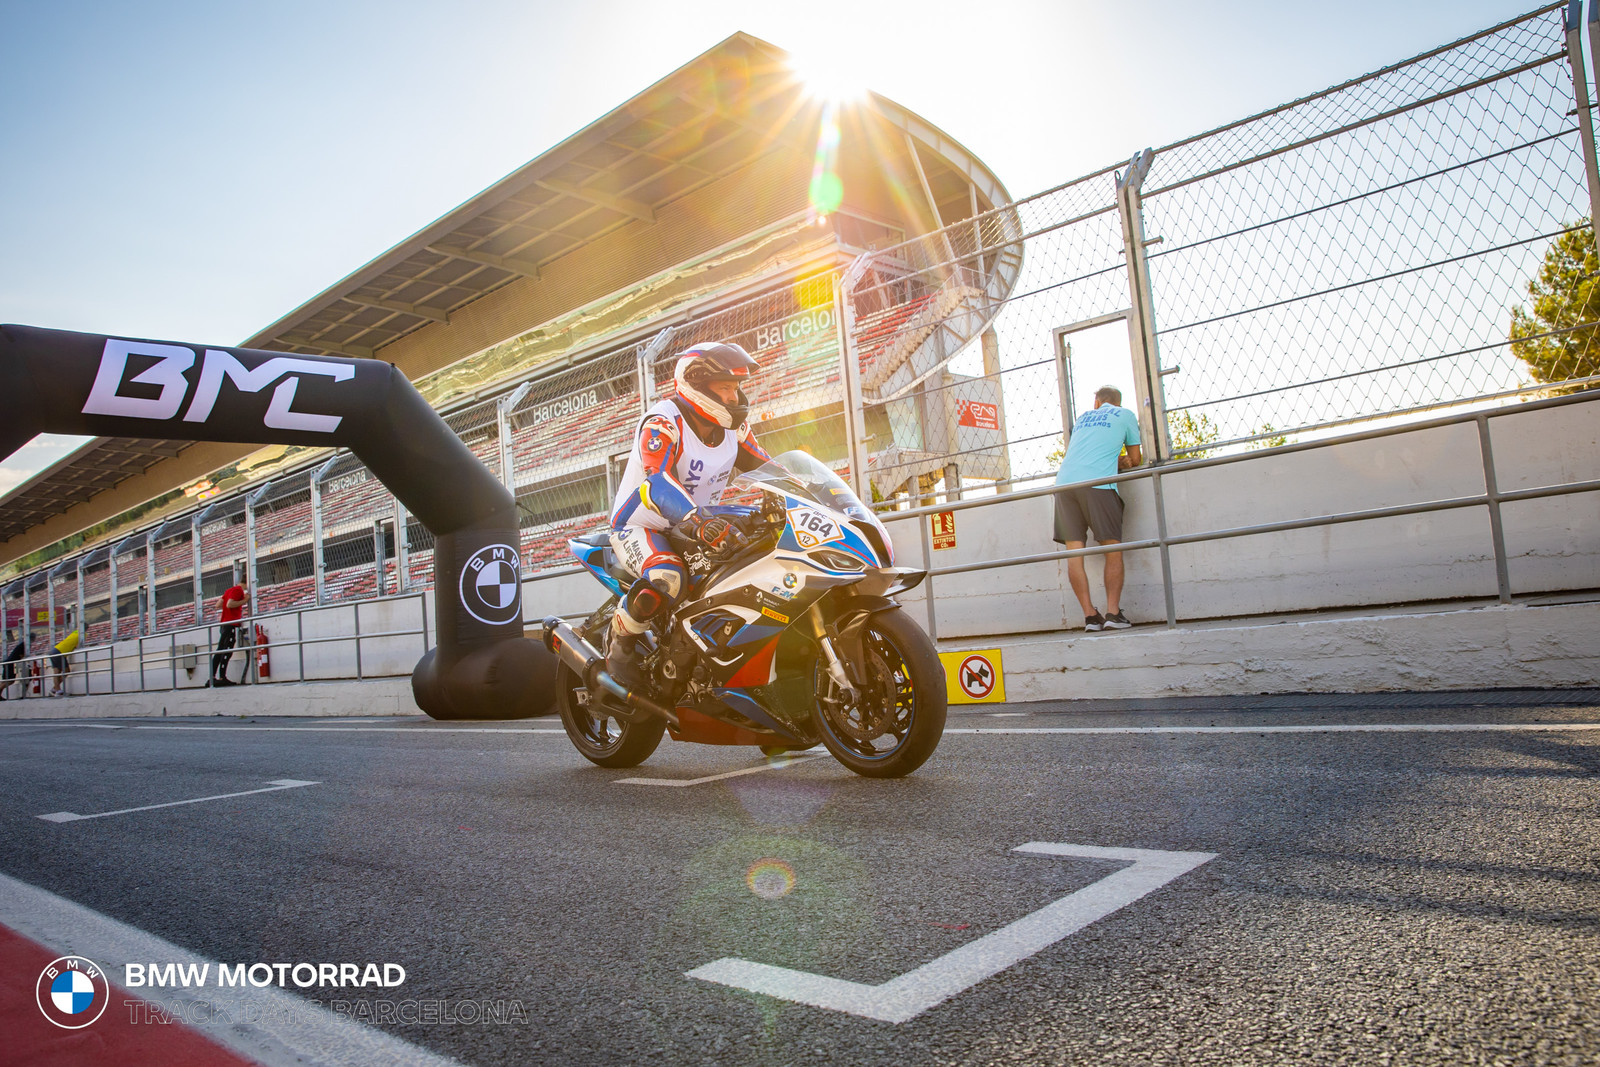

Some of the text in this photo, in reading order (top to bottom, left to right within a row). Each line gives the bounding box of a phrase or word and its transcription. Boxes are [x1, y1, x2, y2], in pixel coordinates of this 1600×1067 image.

[756, 310, 836, 349] Barcelo
[81, 338, 355, 433] BMC
[533, 390, 597, 426] Barcelona
[800, 512, 833, 538] 164
[622, 540, 635, 562] LIFE
[631, 540, 644, 564] MAKE
[802, 535, 811, 545] 12
[470, 548, 519, 572] BMW
[764, 608, 787, 622] PIRELLI
